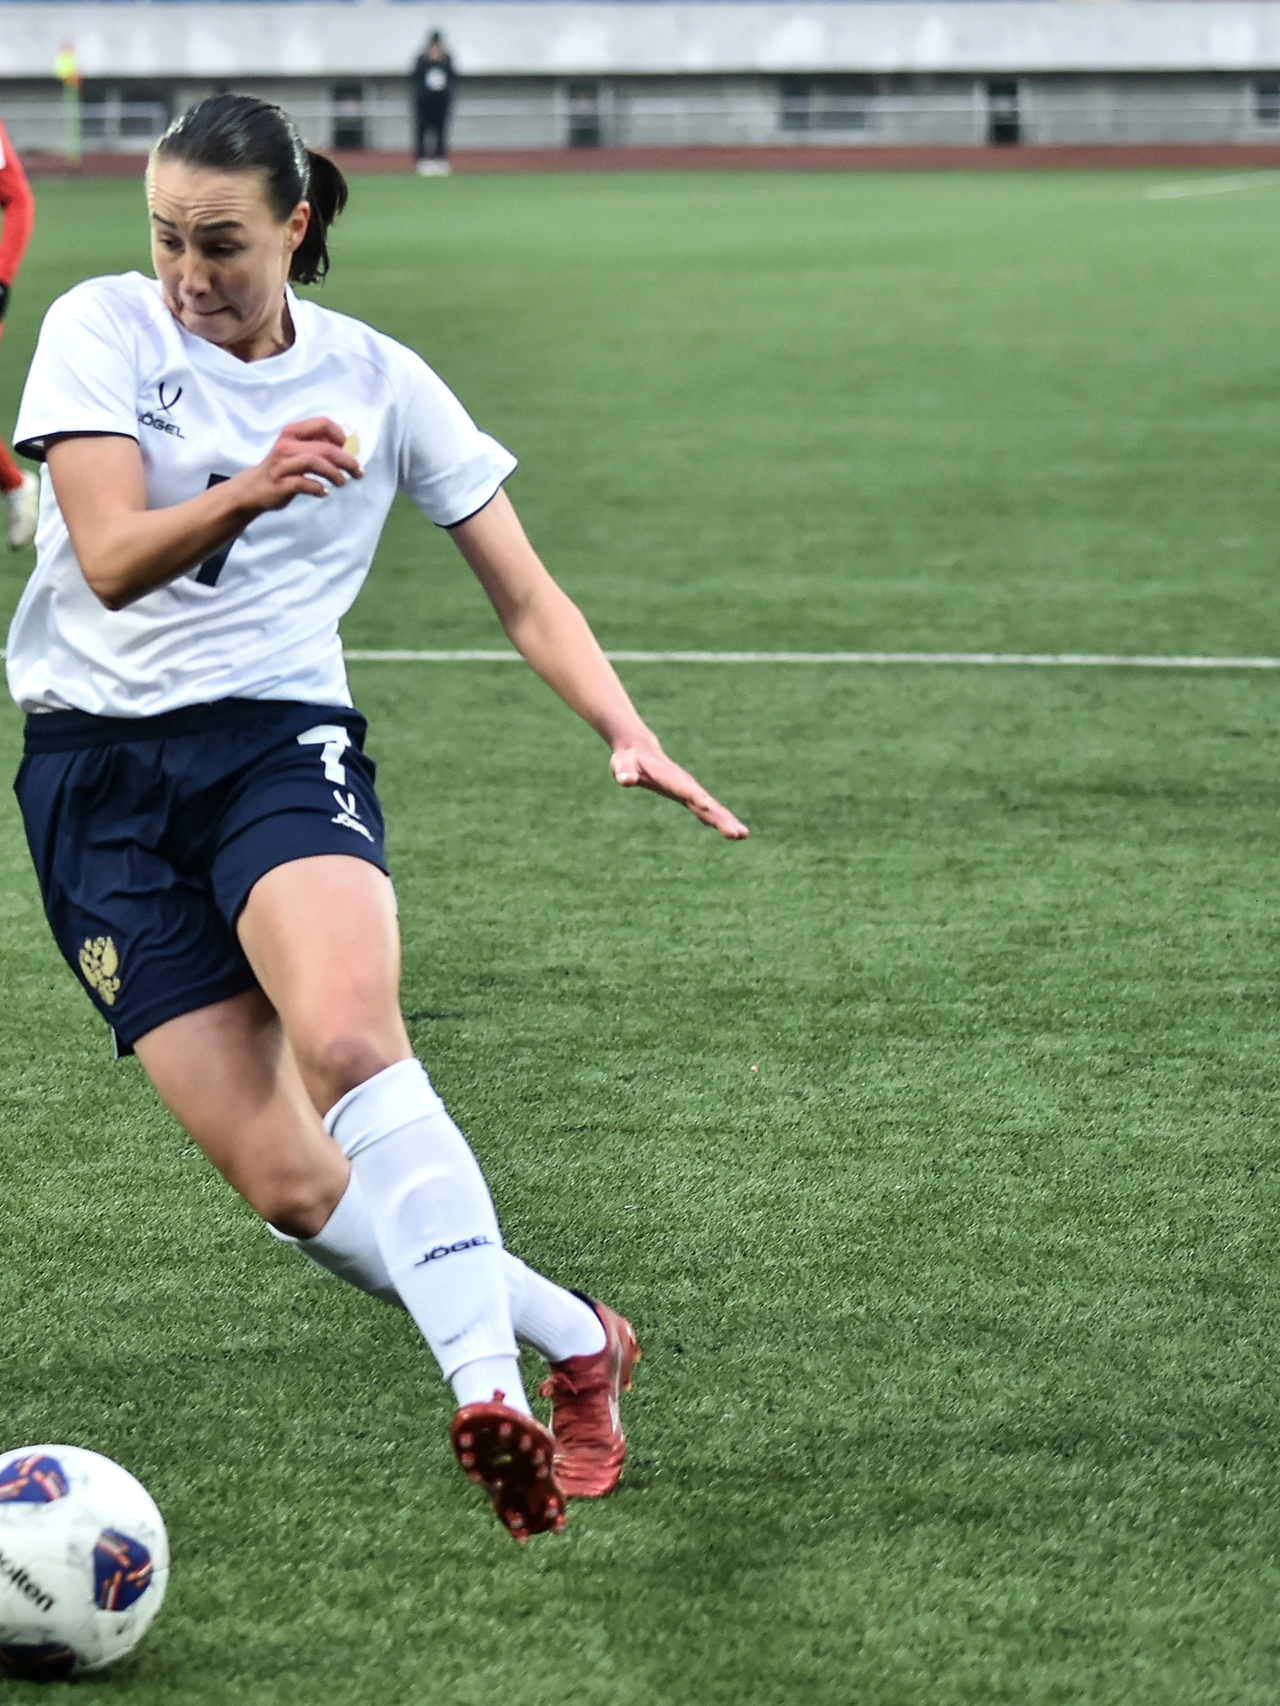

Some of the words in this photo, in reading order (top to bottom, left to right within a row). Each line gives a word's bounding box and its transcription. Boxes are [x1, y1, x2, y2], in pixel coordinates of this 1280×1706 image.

[138, 410, 185, 440] ÖGEL
[296, 724, 352, 786] 7
[413, 1235, 495, 1267] JÖGEL
